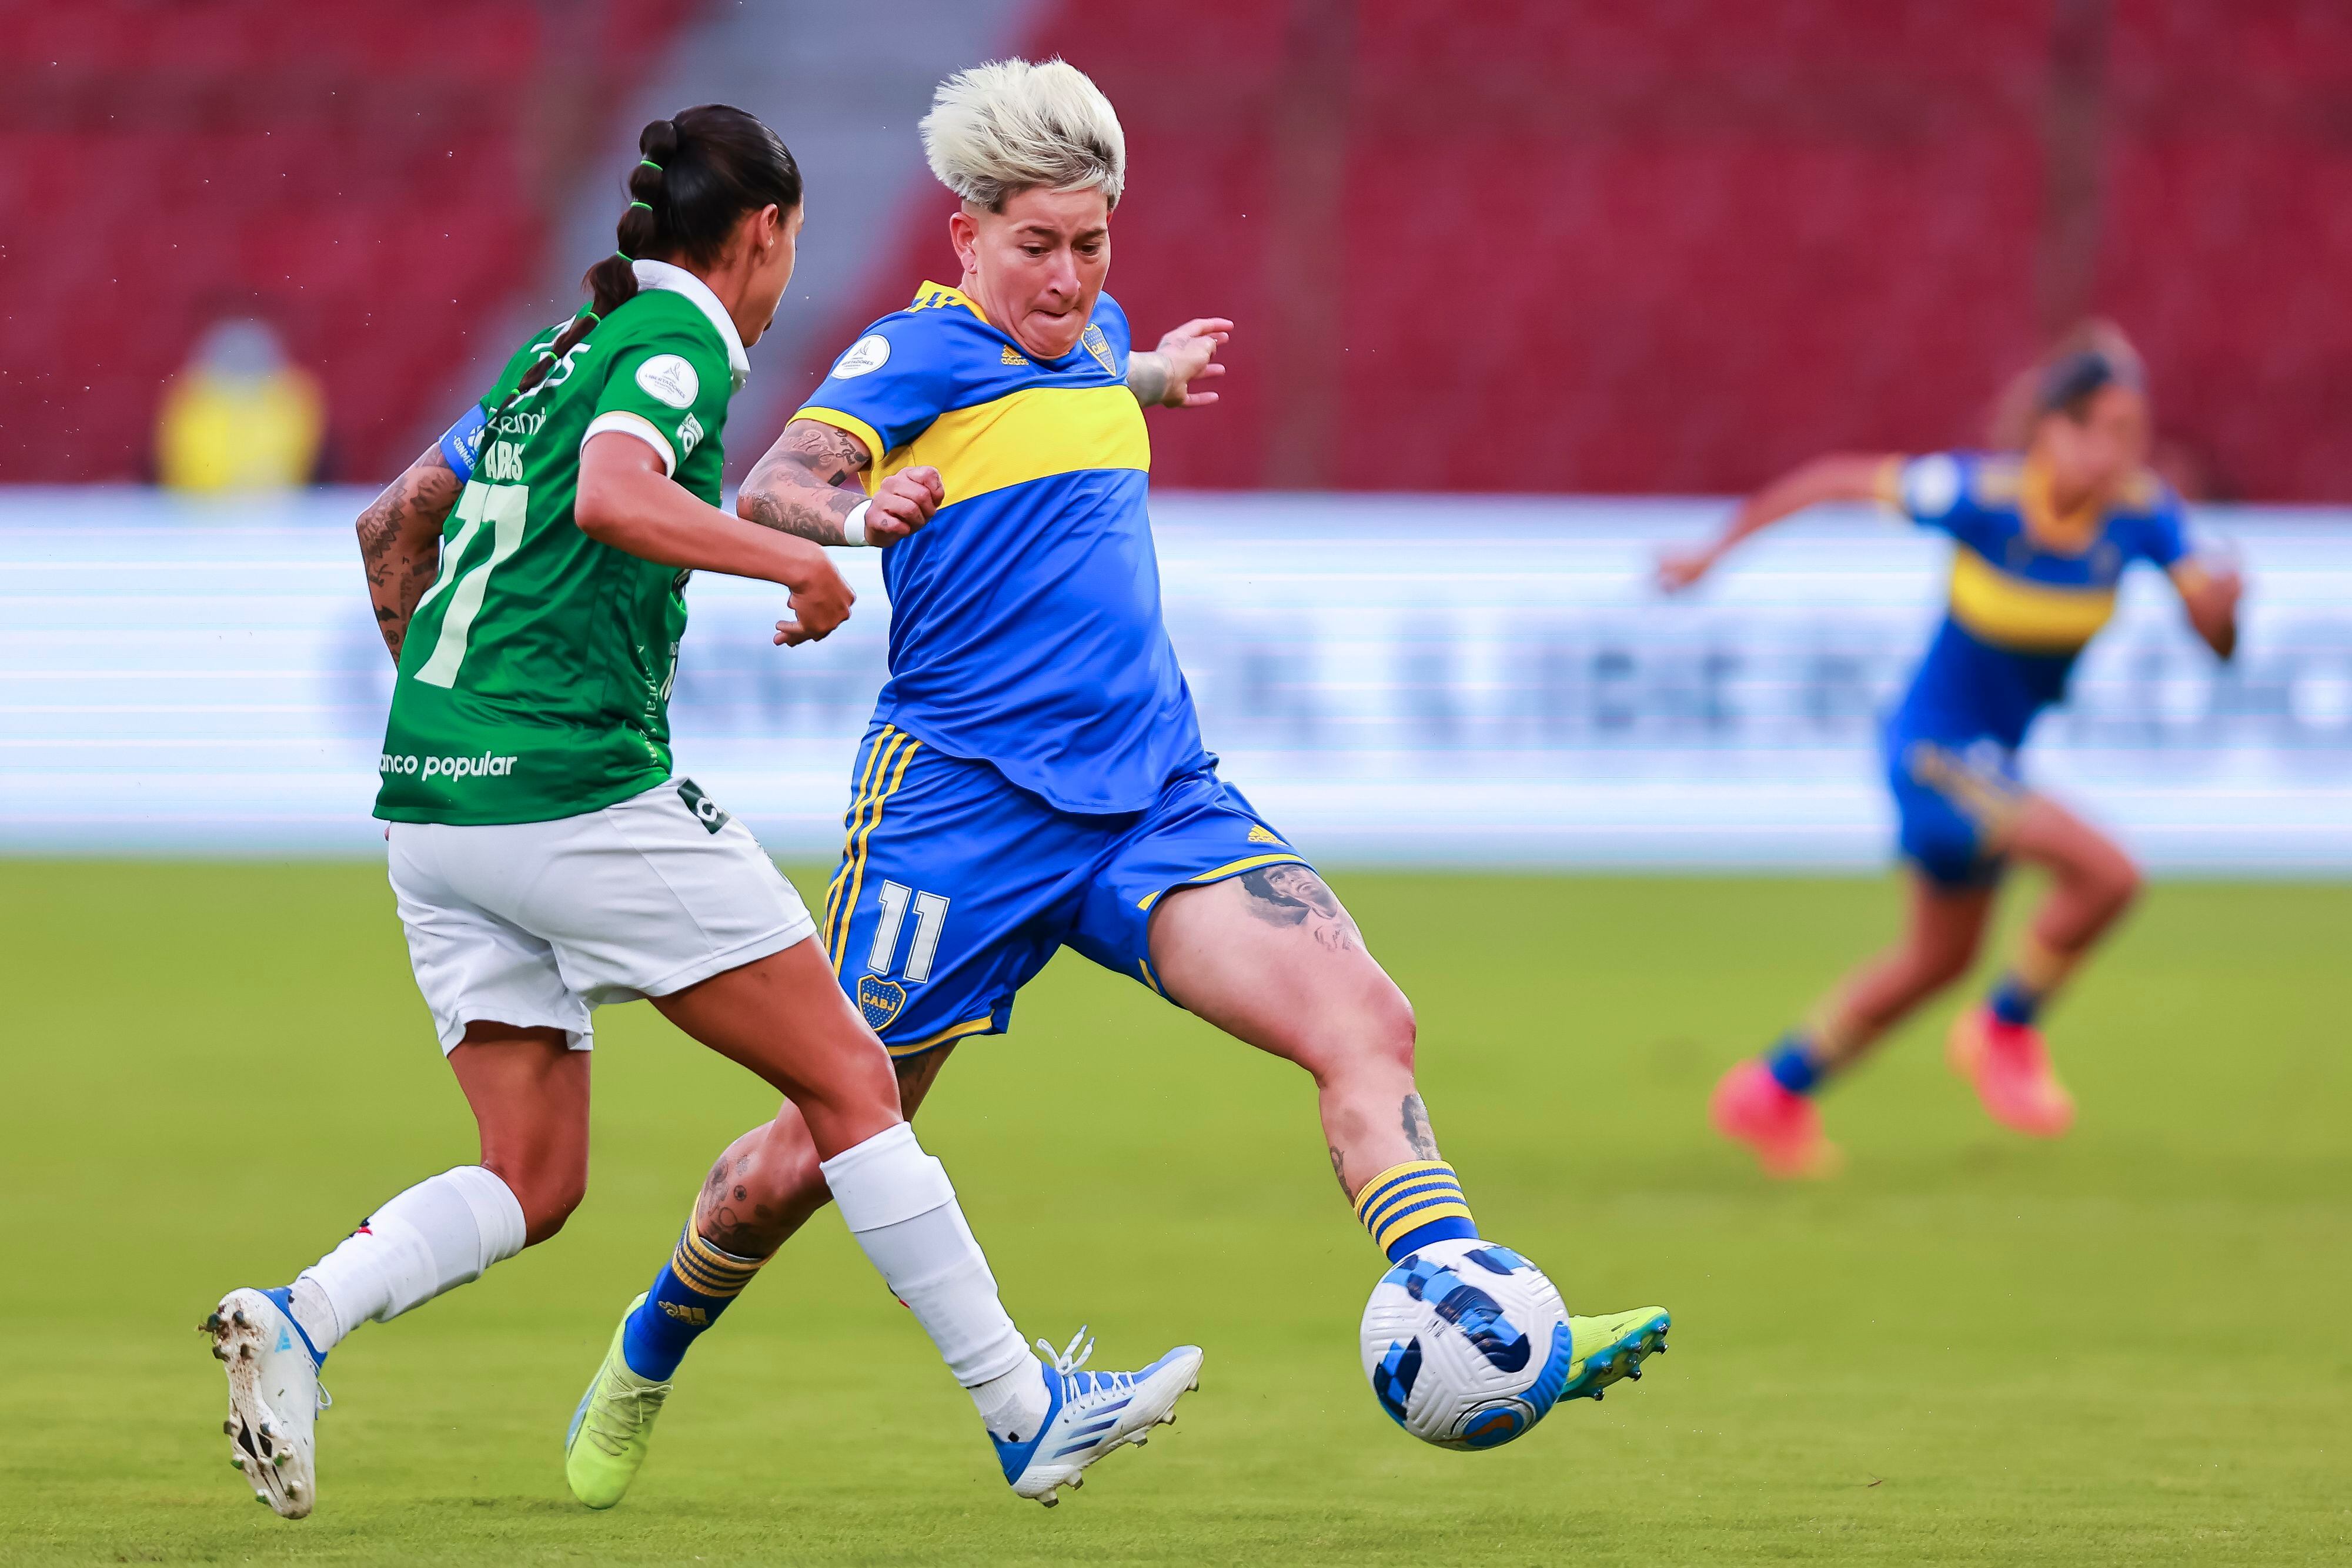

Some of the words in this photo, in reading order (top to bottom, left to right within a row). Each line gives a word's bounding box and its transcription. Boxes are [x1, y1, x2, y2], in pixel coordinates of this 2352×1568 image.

[453, 435, 476, 470] CONMEB
[379, 753, 419, 774] anco
[422, 750, 517, 783] popular
[867, 879, 951, 984] 11
[862, 992, 896, 1012] CABJ
